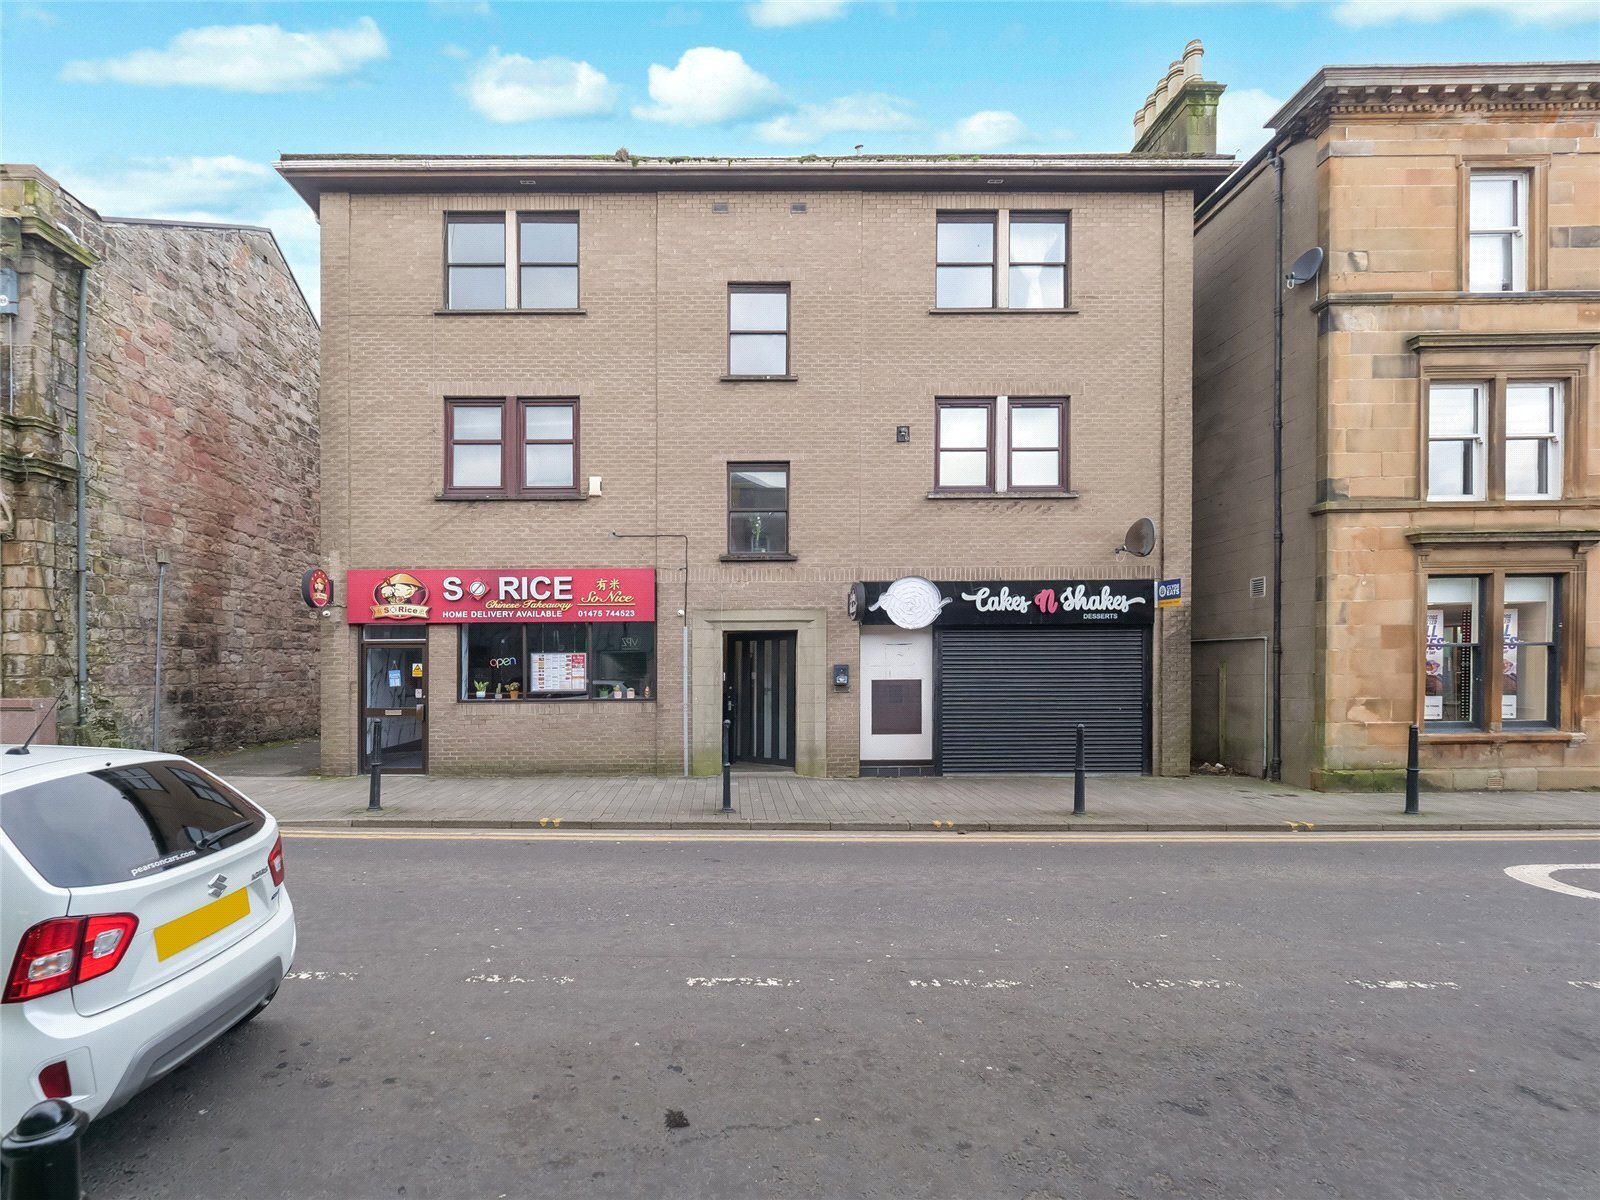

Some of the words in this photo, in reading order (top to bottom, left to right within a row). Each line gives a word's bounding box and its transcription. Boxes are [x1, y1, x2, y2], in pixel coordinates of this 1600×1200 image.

[498, 576, 573, 600] RICE
[596, 578, 620, 591] 有米
[581, 591, 600, 603] So
[600, 591, 635, 603] Nice
[961, 586, 1032, 614] Cakes
[1060, 584, 1146, 613] Shakes
[398, 606, 418, 614] Rice
[485, 600, 521, 609] Chinese
[522, 600, 574, 611] Takeaway
[516, 610, 563, 618] AVAILABLE
[578, 609, 603, 617] 01475
[605, 609, 635, 617] 744523
[490, 657, 517, 669] open
[131, 850, 197, 877] pearsoncars.com
